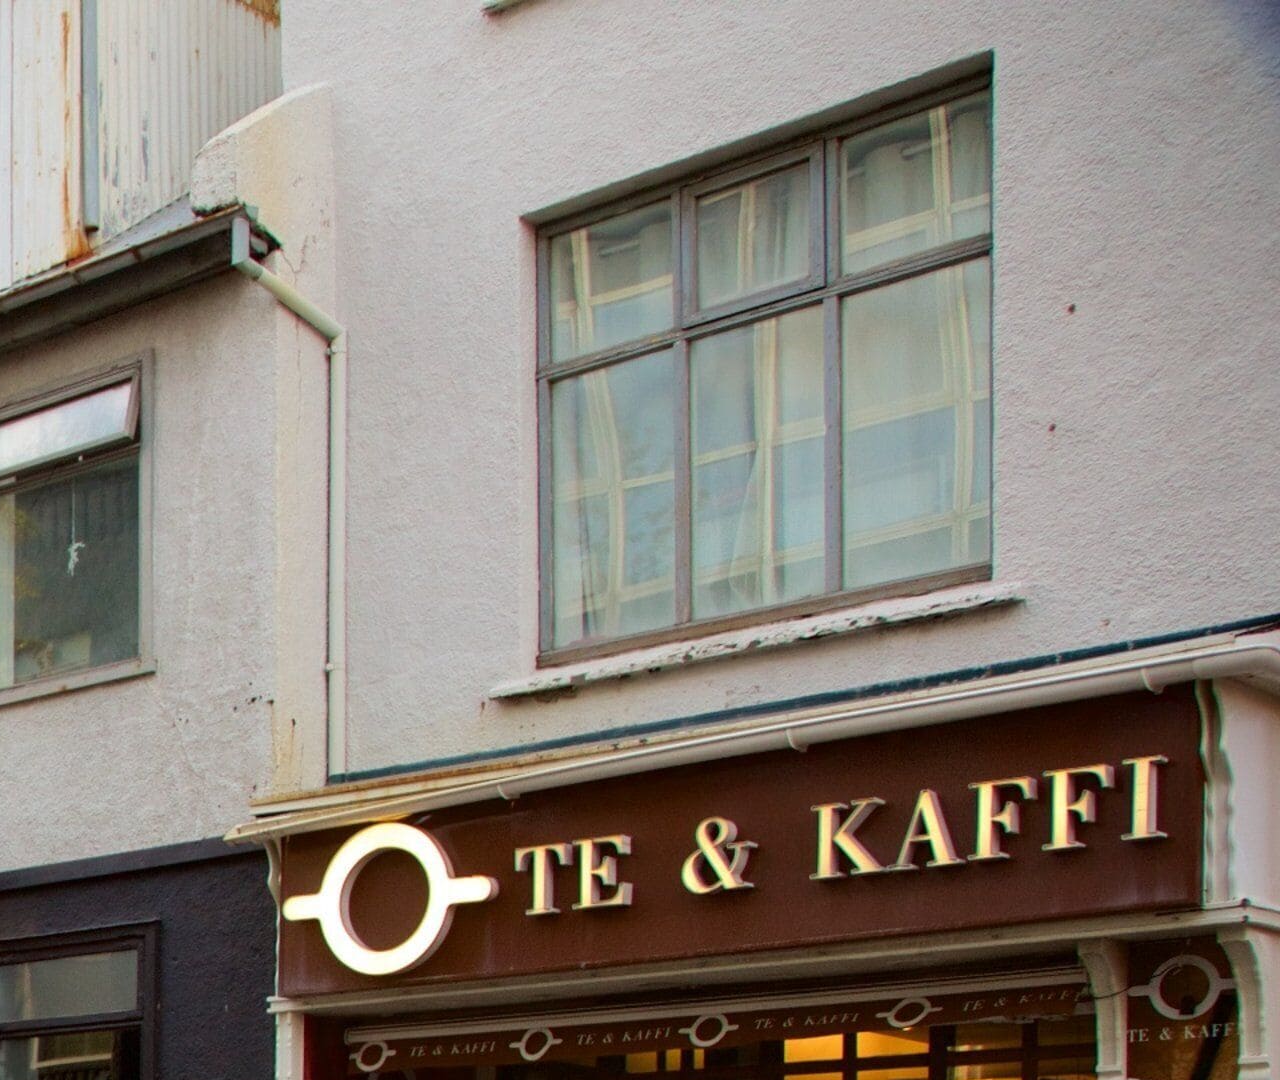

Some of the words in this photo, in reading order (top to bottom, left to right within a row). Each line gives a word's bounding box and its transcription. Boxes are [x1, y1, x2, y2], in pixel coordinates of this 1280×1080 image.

[514, 833, 633, 916] TE
[681, 816, 758, 895] &
[809, 754, 1169, 881] KAFFI
[754, 1018, 774, 1030] TE
[782, 1015, 794, 1027] &
[804, 1012, 860, 1026] KAFFI
[576, 1034, 593, 1045] TE
[602, 1031, 614, 1043] &
[622, 1026, 673, 1042] KAFFI
[1127, 1028, 1149, 1043] TE
[1159, 1027, 1172, 1041] &
[1184, 1022, 1239, 1039] KAFF
[409, 1045, 427, 1057] TE
[451, 1040, 497, 1055] KAFFI
